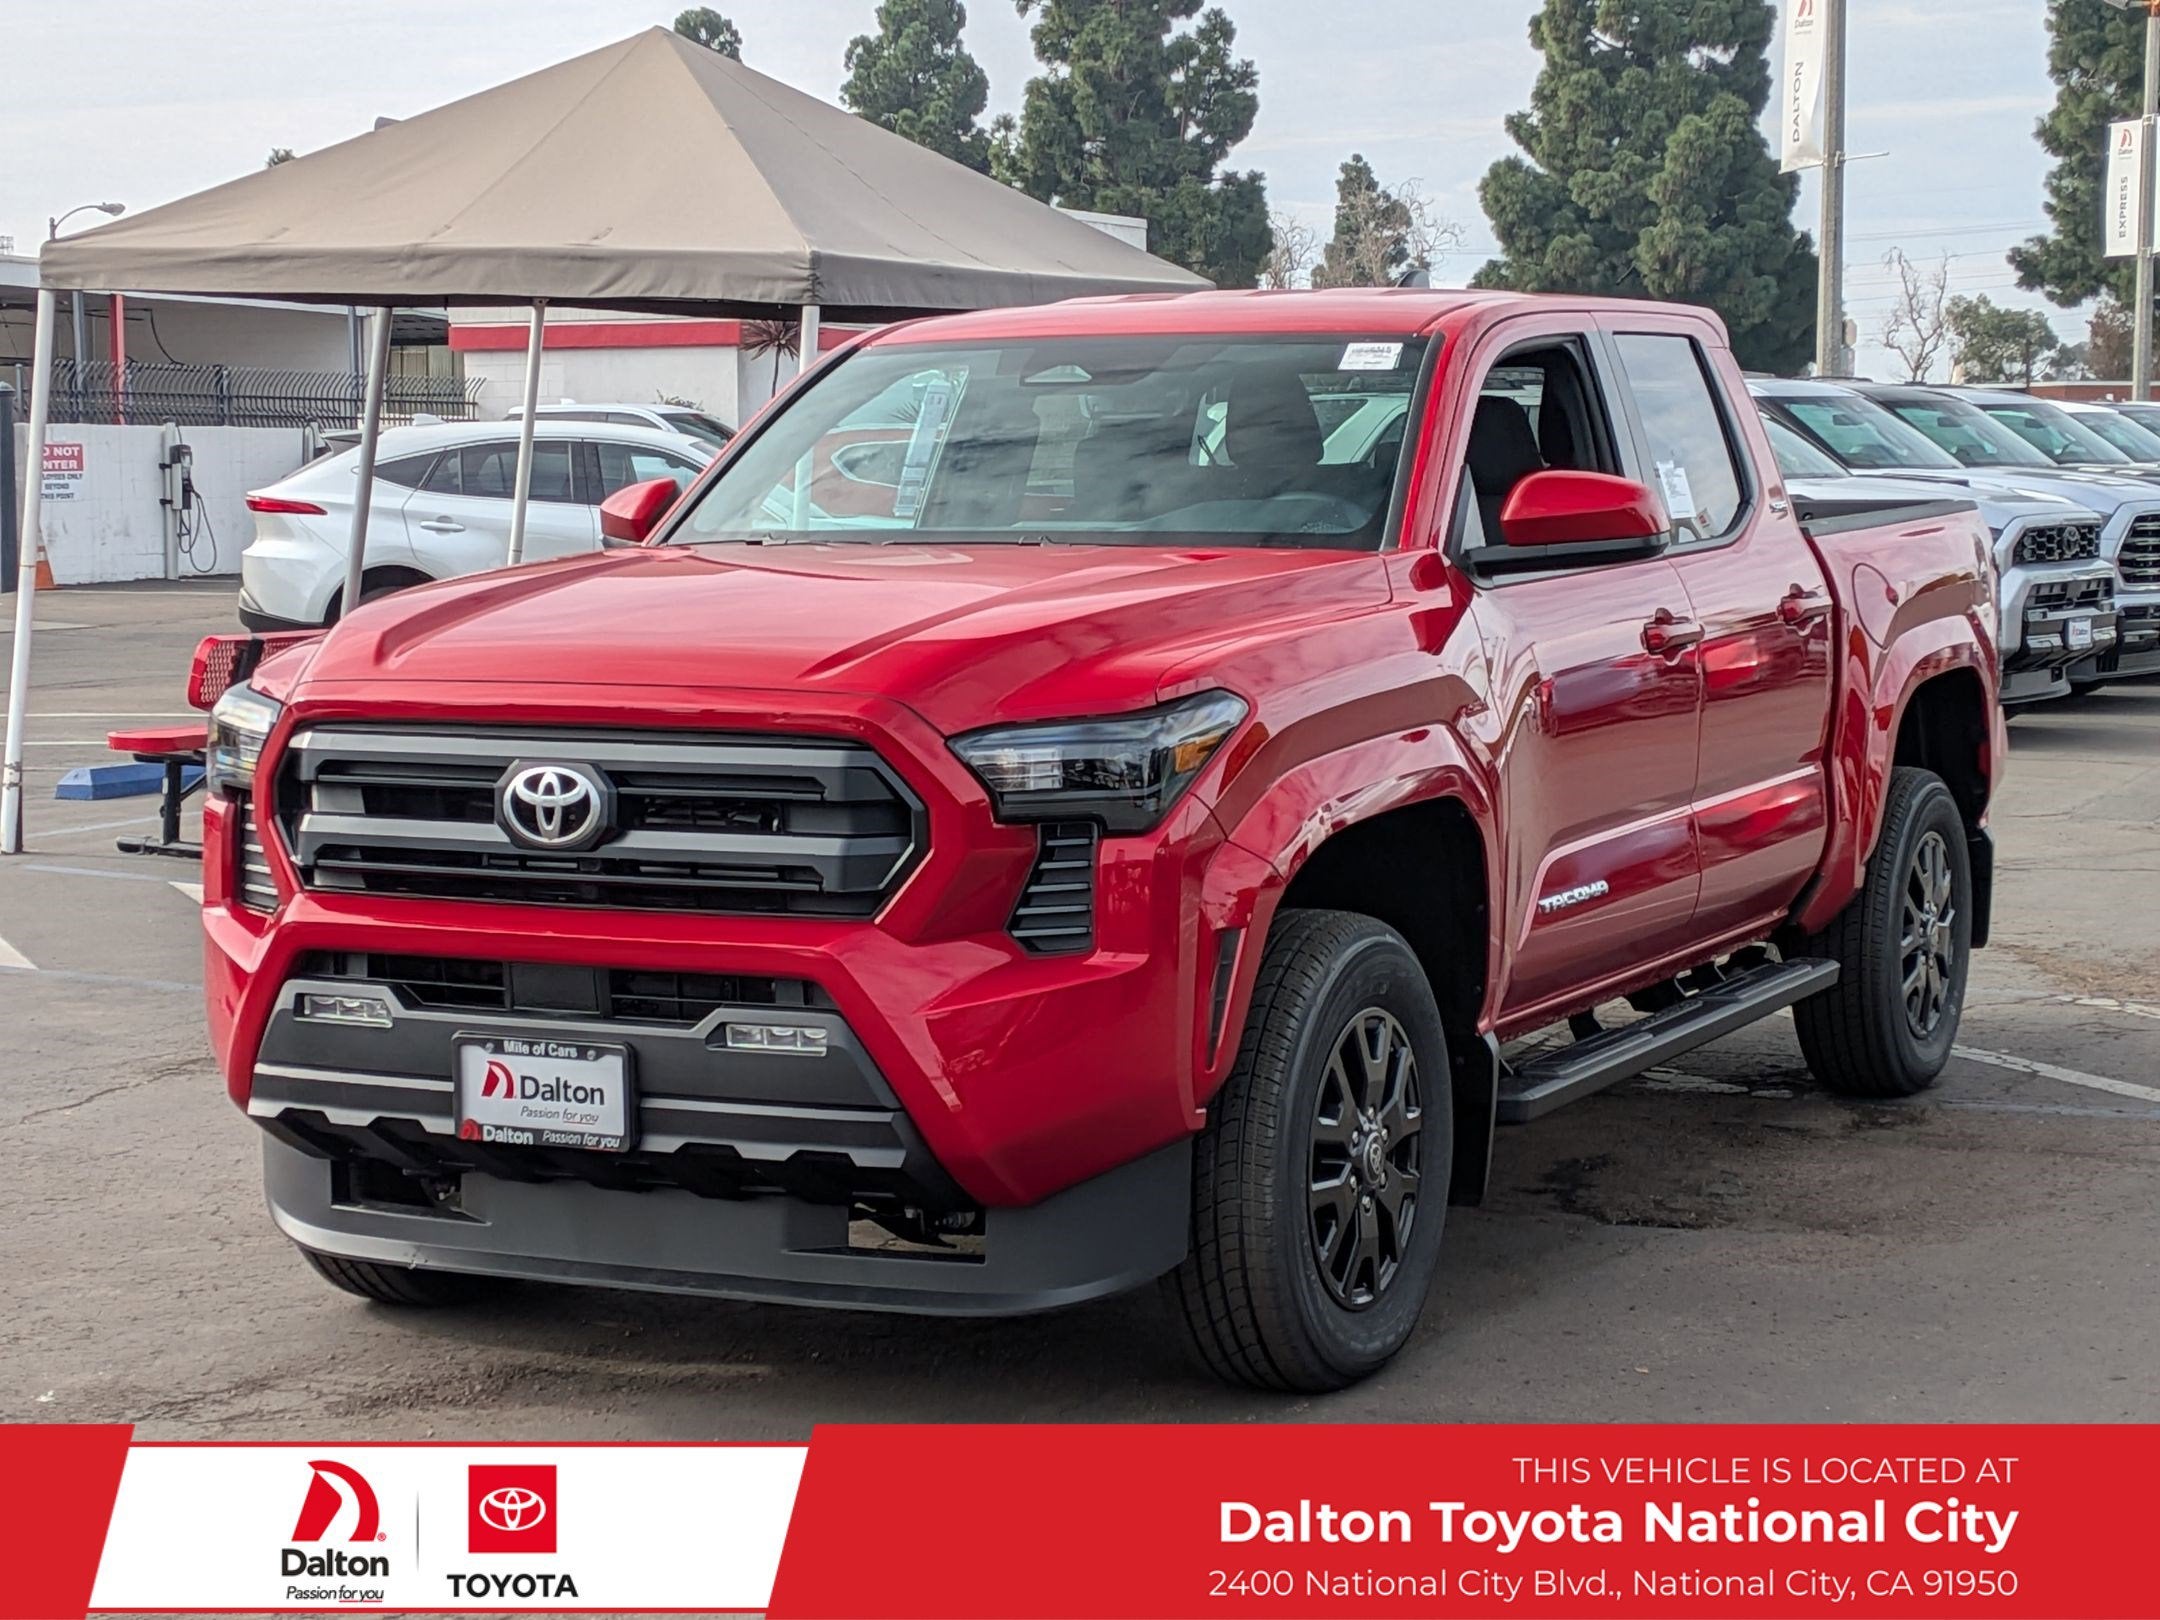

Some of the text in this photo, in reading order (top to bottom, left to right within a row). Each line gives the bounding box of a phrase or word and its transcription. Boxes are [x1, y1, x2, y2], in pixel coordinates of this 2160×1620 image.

[1793, 61, 1804, 143] DALTON
[2119, 176, 2129, 239] EXPRESS
[53, 446, 80, 457] NOT
[43, 460, 77, 470] NTER
[1538, 880, 1609, 914] TACOMA
[503, 1040, 578, 1058] Mile of Cars
[520, 1075, 605, 1106] Dalton
[520, 1106, 600, 1123] Passion for you
[482, 1125, 620, 1149] Dalton Passion for you
